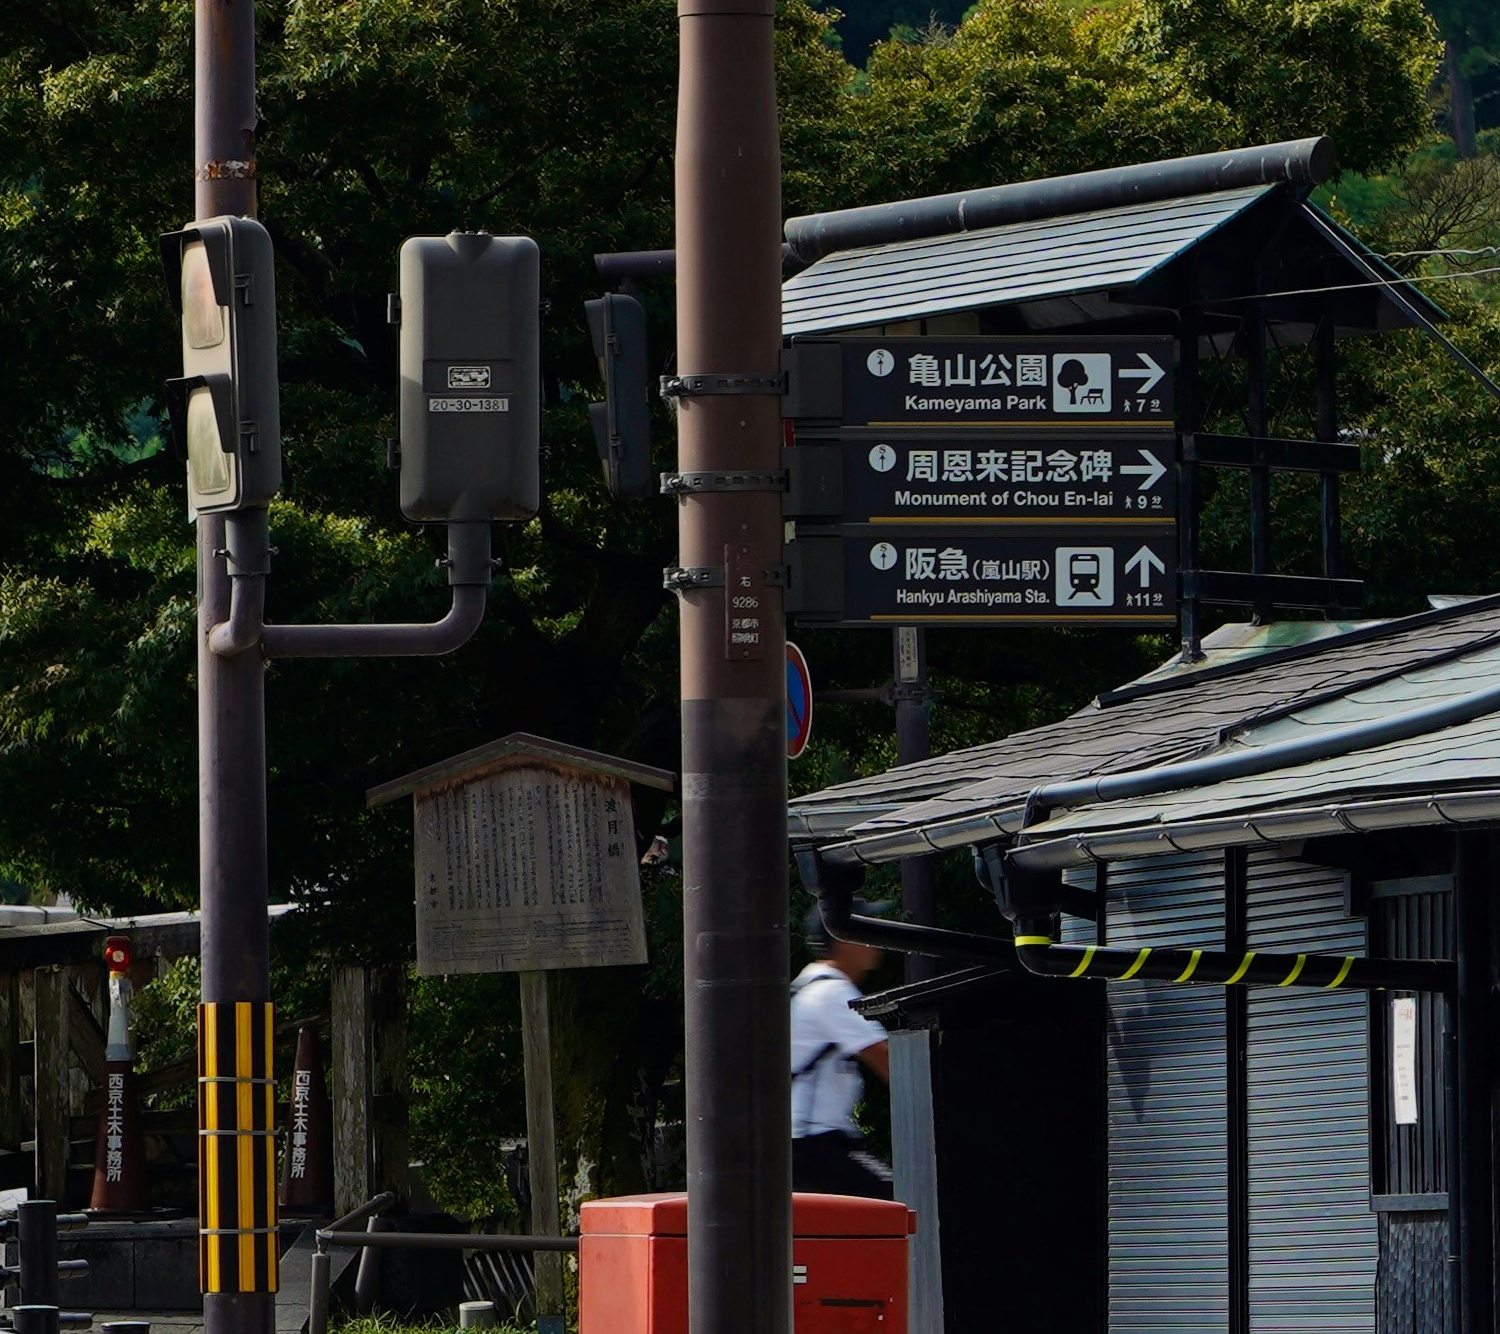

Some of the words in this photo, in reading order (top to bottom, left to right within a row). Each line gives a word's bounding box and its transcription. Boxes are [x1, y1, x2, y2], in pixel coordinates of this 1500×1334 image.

[907, 352, 1048, 387] 亀山公園
[431, 399, 506, 411] 20-30-1381
[904, 394, 1002, 414] Kameyama
[1006, 394, 1047, 410] Park
[905, 448, 1114, 484] 周恩来記念碑
[894, 490, 989, 507] Monument
[991, 490, 1010, 507] of
[1012, 490, 1062, 507] Chou
[1064, 490, 1114, 507] En-lai
[896, 588, 945, 607] Hankyu
[947, 588, 1022, 607] Arashiyama
[1024, 588, 1051, 604] Sta.
[105, 1072, 125, 1183] 西京土木事務所
[289, 1069, 312, 1179] 西京土木事務所
